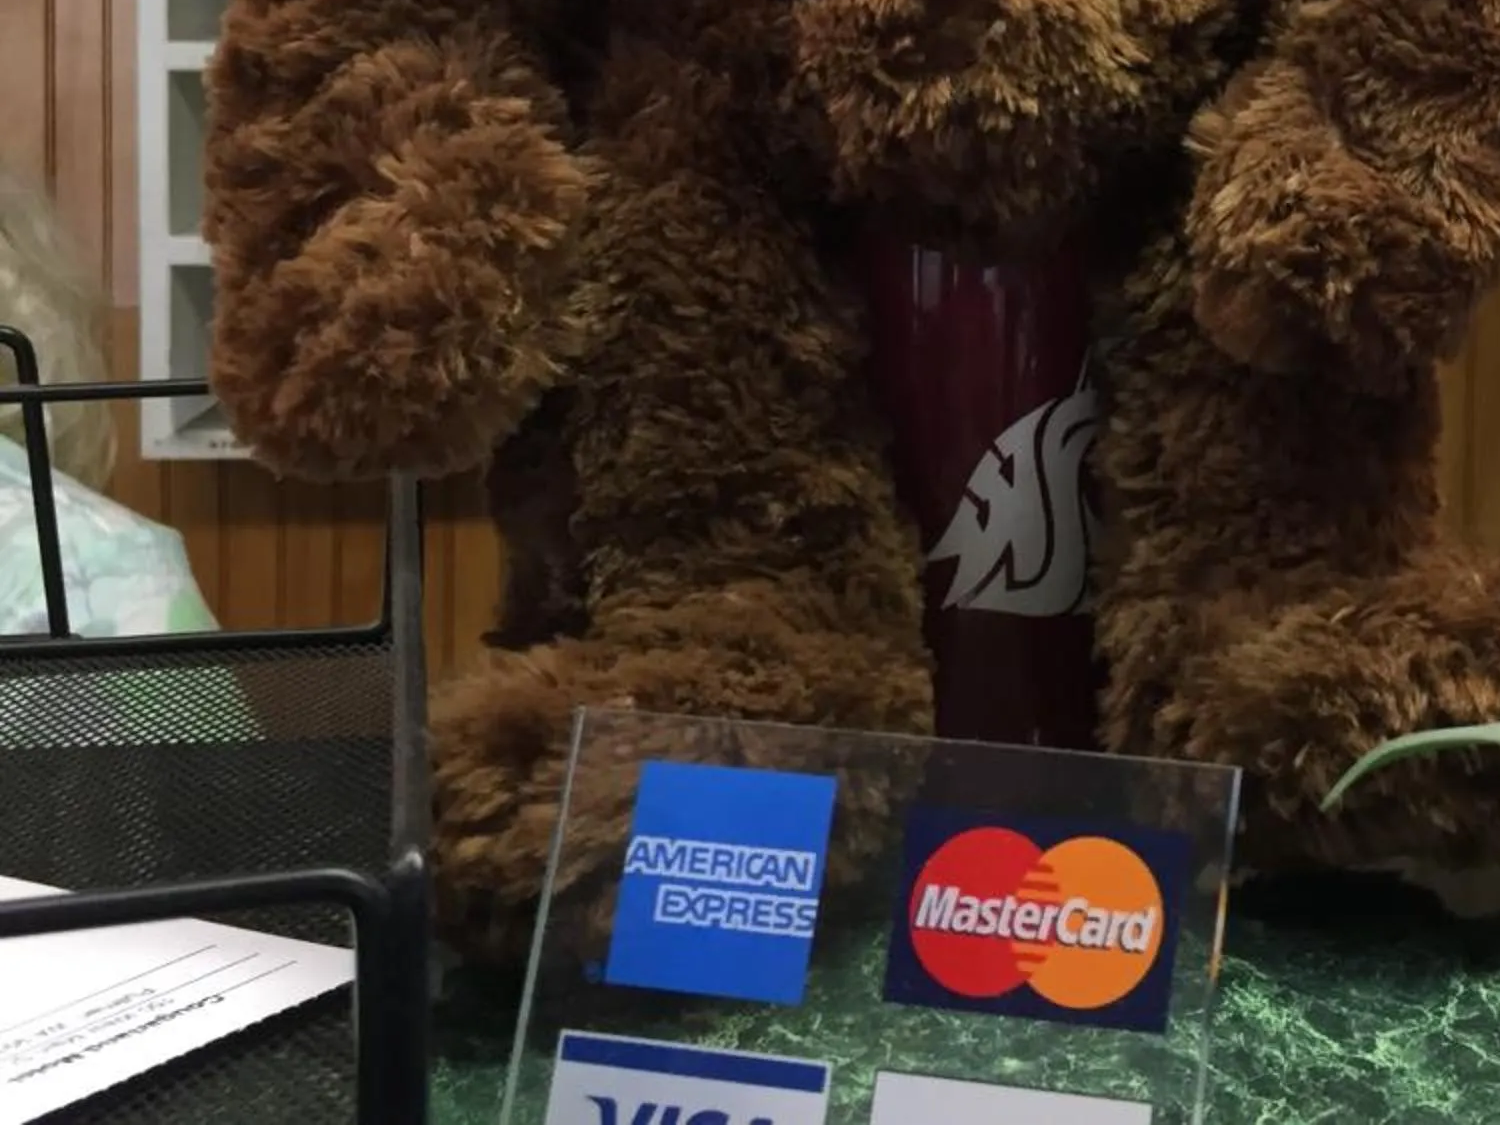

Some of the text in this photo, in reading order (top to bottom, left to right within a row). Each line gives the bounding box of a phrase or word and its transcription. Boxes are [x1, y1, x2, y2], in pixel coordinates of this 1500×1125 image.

[625, 836, 815, 890] AMERICAN
[655, 884, 818, 937] EXPRESS
[915, 883, 1157, 953] MasterCard
